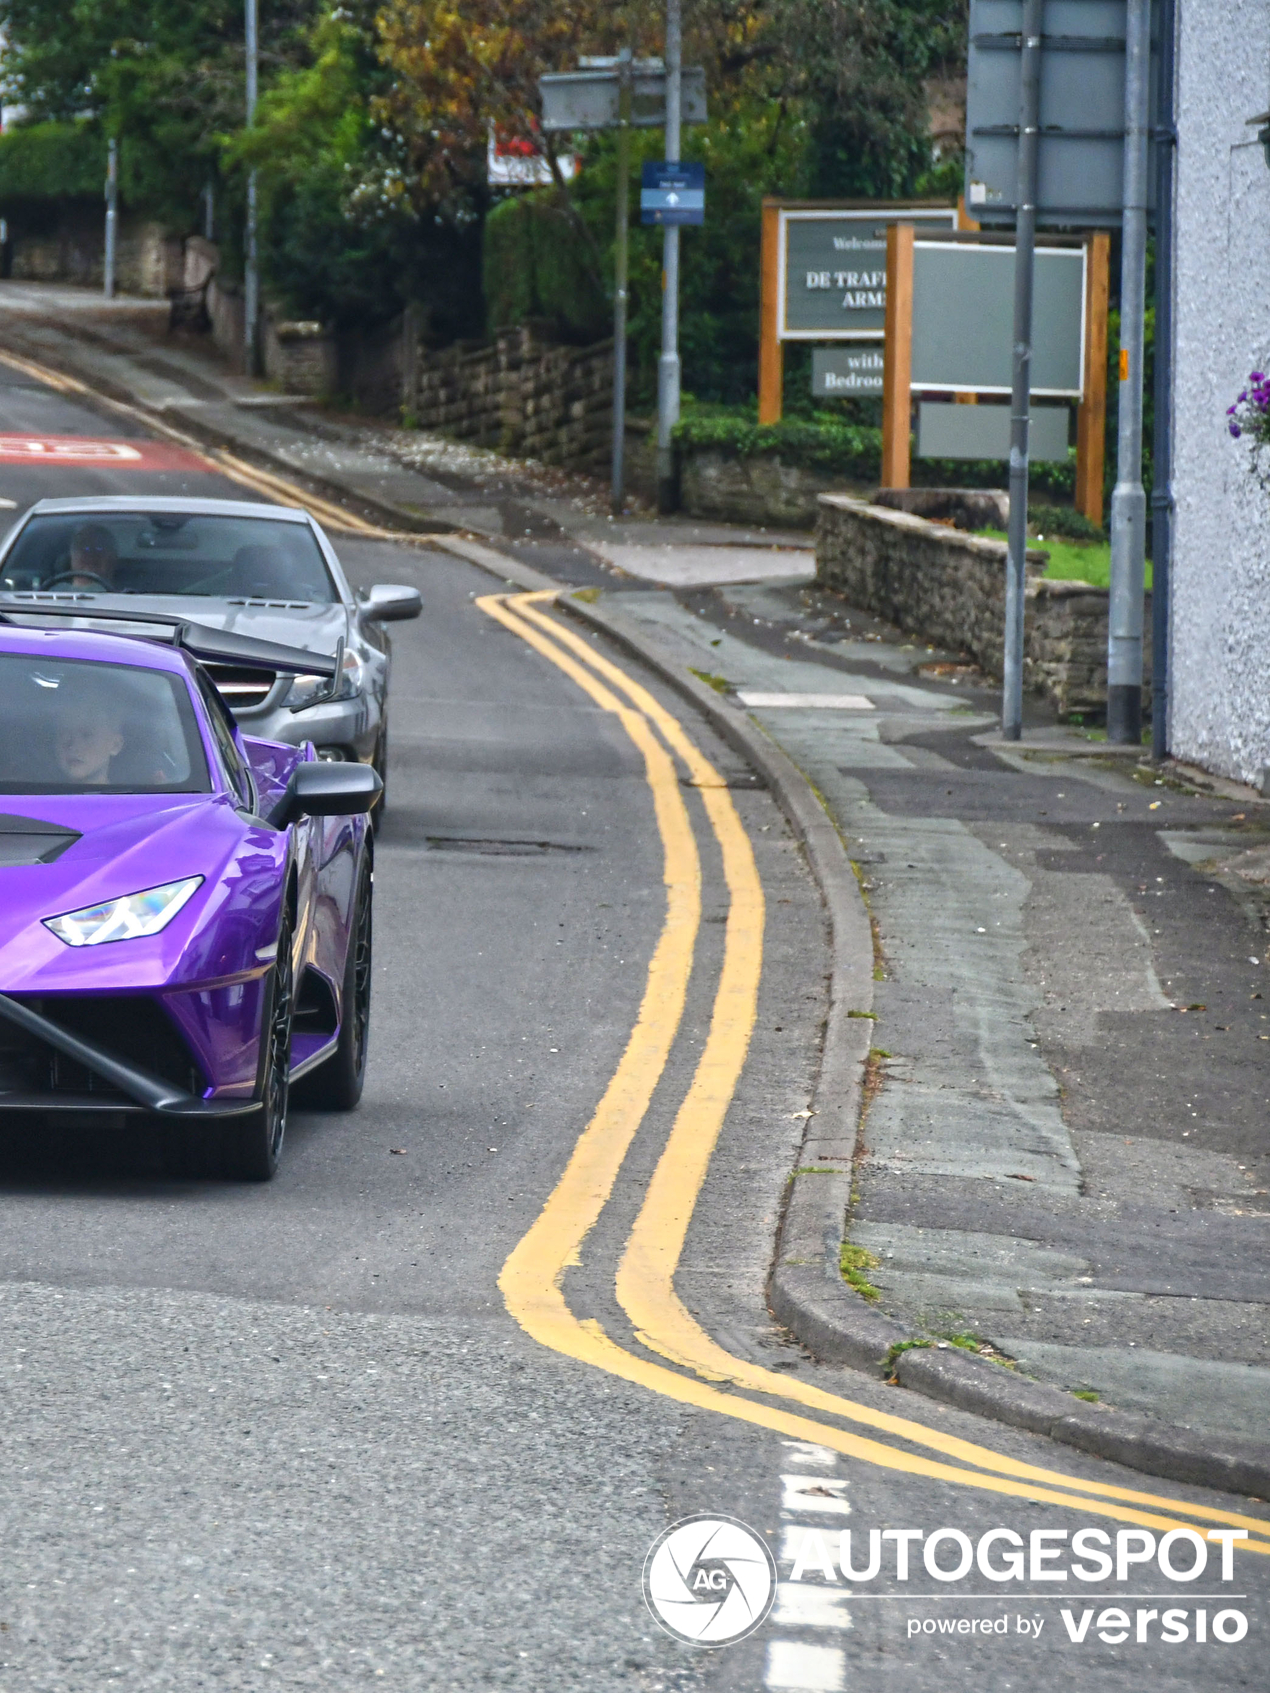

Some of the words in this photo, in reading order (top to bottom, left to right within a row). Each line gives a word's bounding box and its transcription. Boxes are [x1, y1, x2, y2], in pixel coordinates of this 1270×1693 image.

[806, 271, 830, 289] DE
[848, 353, 884, 369] with
[825, 372, 883, 388] Bedroo
